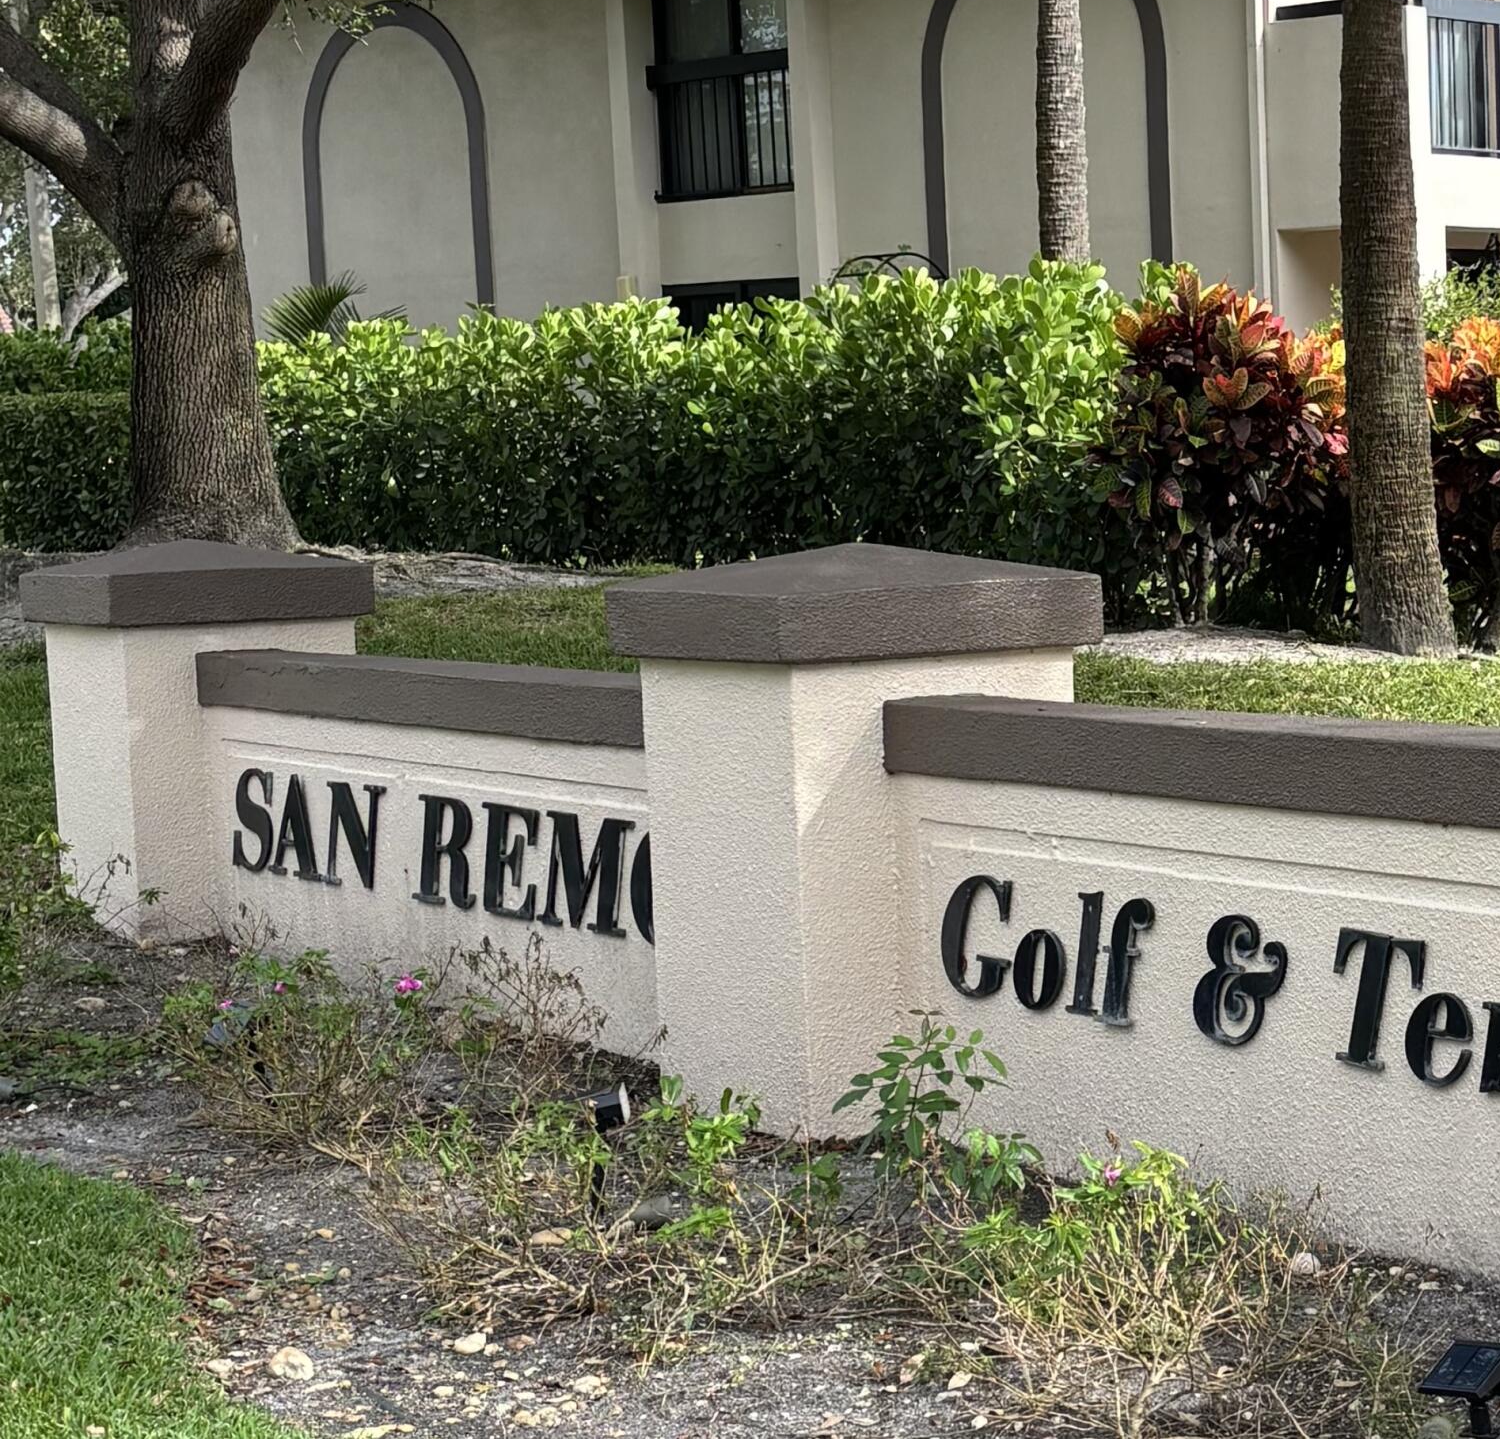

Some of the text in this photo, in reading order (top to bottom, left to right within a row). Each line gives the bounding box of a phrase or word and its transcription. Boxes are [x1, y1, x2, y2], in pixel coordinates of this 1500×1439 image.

[232, 767, 388, 890] SAN
[941, 874, 1157, 1028] Golf
[1193, 914, 1289, 1047] &
